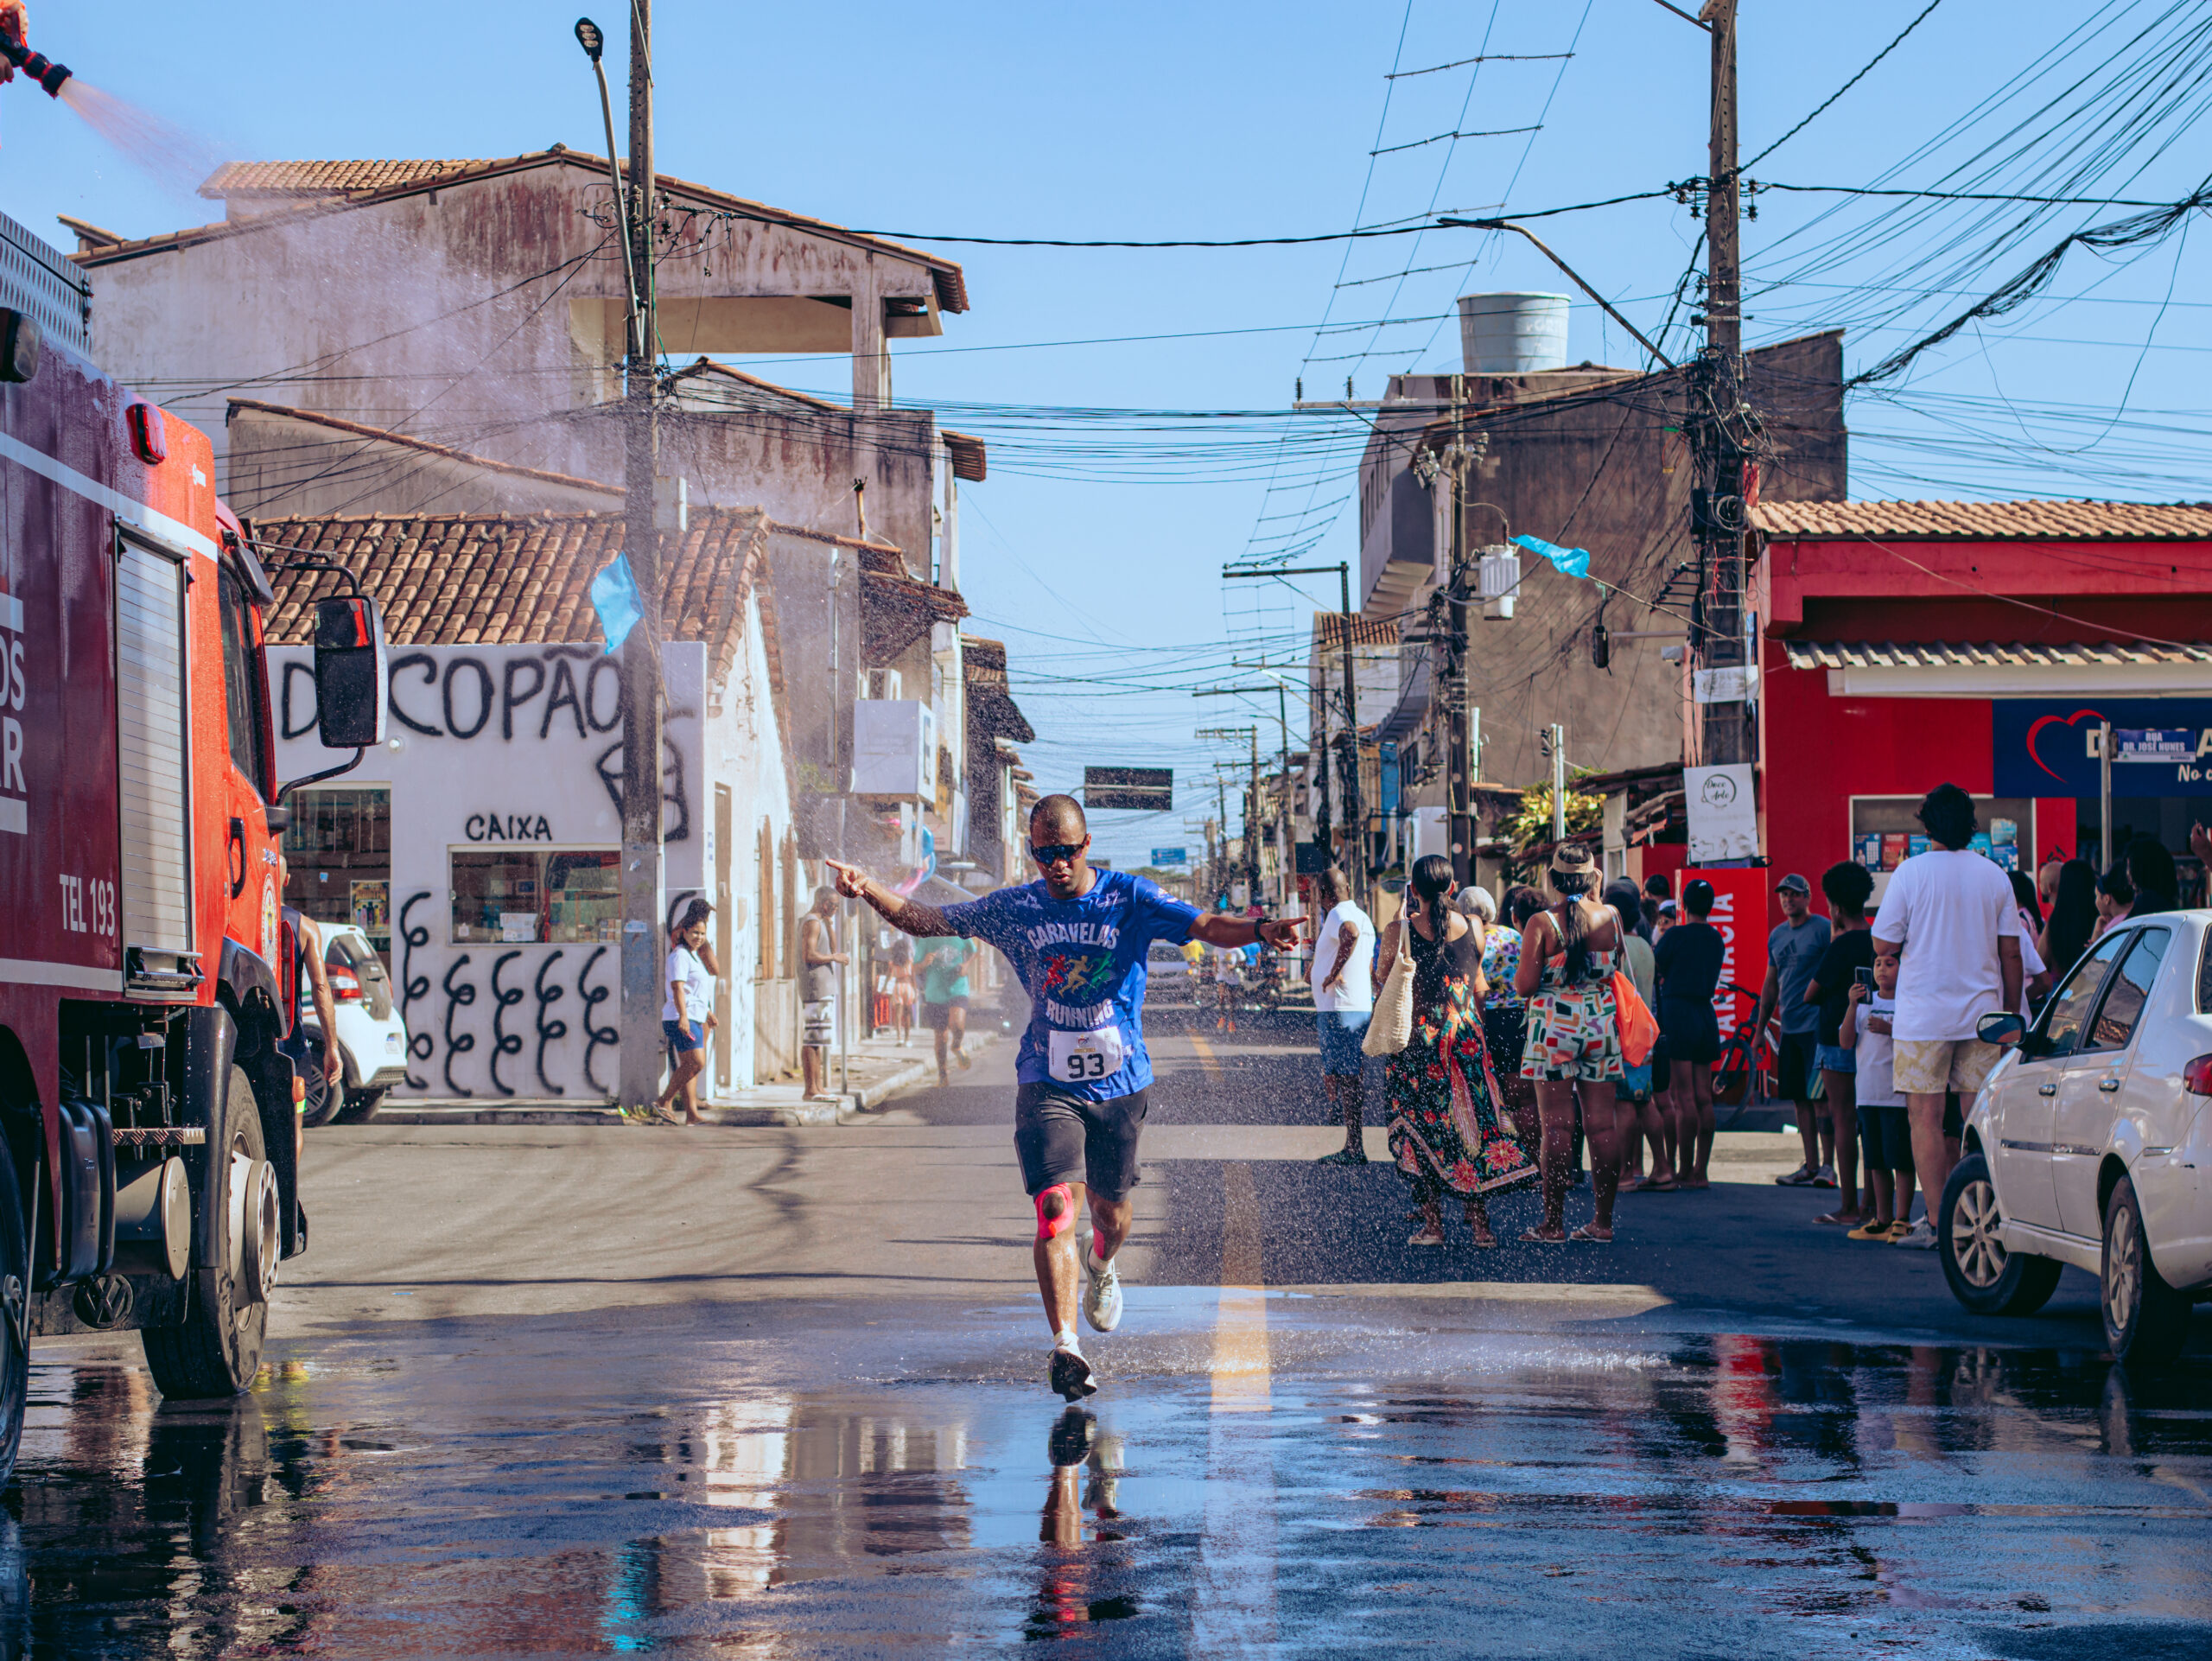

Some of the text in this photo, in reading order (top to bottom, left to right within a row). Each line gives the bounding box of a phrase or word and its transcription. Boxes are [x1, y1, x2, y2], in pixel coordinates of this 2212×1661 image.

[2145, 732, 2163, 741] RUA
[2158, 741, 2185, 752] NUNES
[2177, 764, 2202, 782] No
[465, 812, 553, 841] CAIXA
[60, 874, 115, 937] TEL 193
[1027, 922, 1120, 950] CARAVELAS
[1045, 997, 1115, 1028] RUNNING
[1067, 1053, 1105, 1079] 93
